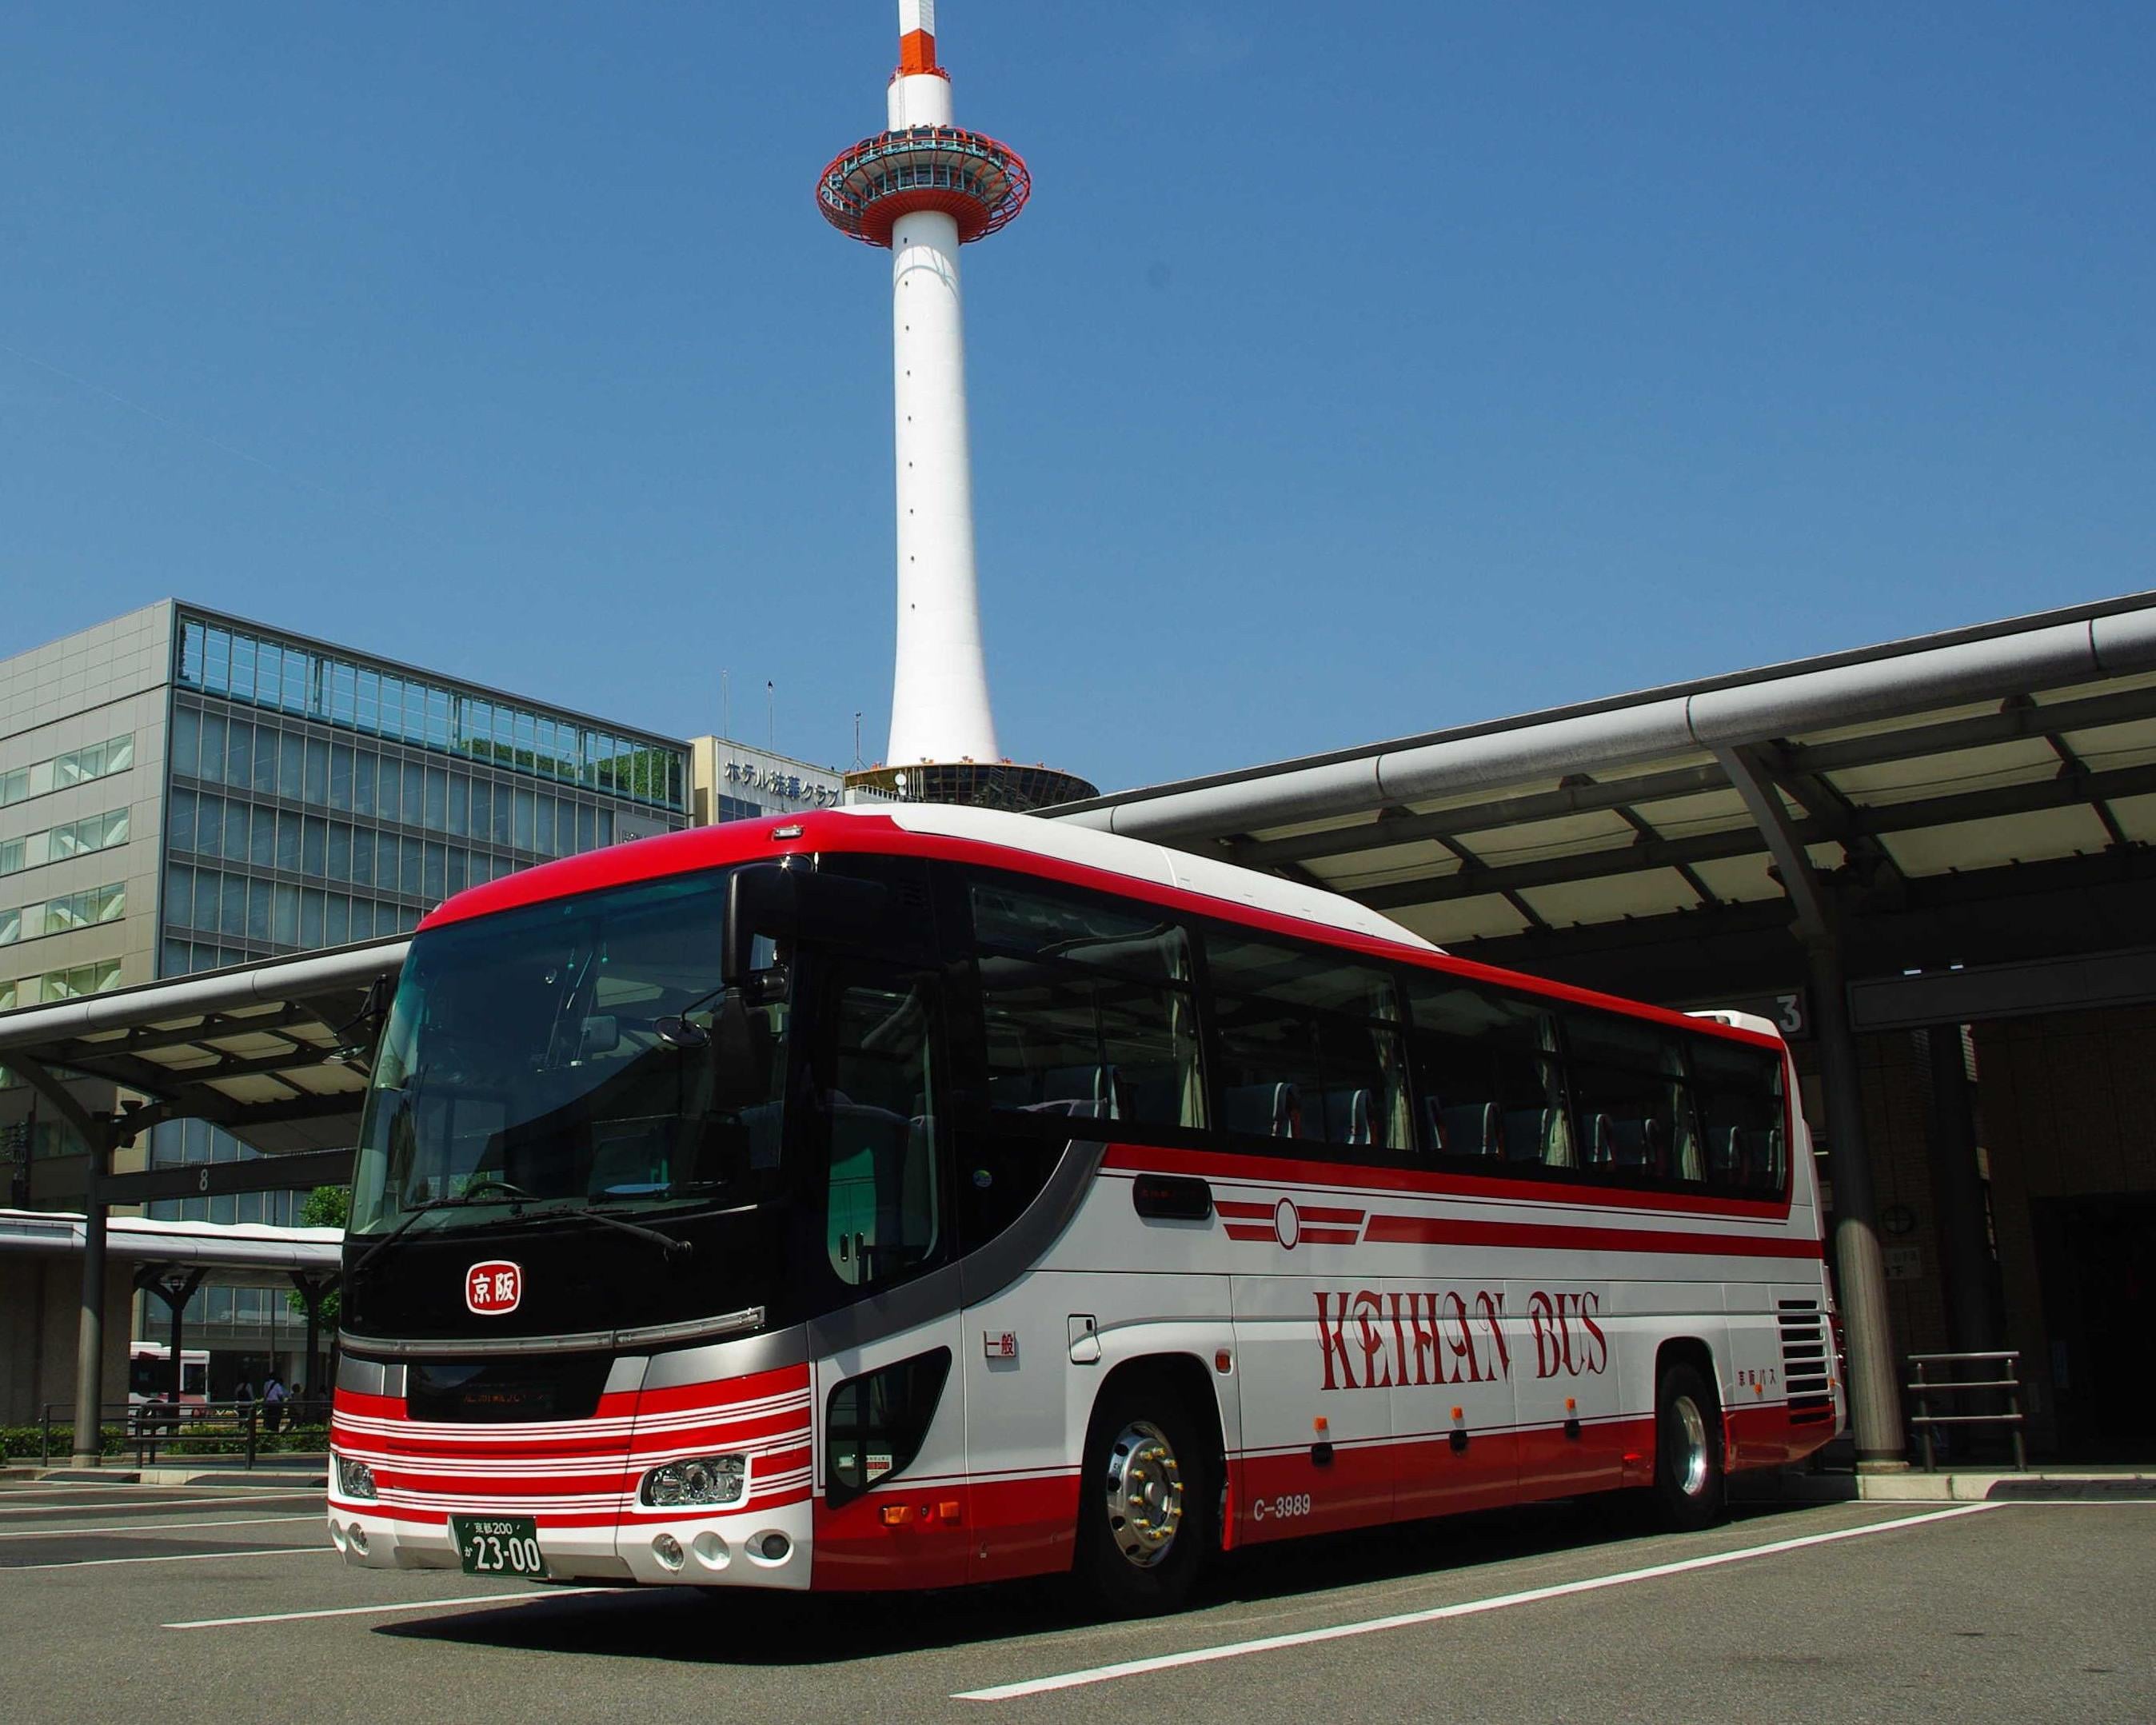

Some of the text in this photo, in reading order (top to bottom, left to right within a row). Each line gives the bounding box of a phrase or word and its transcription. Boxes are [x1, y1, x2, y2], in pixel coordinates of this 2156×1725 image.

[1776, 994, 1803, 1033] 3
[200, 1168, 208, 1191] 8
[472, 1272, 515, 1304] 京阪
[987, 1333, 1013, 1355] 一般
[1312, 1290, 1607, 1390] KEIHAN BUS
[1254, 1494, 1311, 1521] C-3989
[472, 1536, 541, 1571] 23-00
